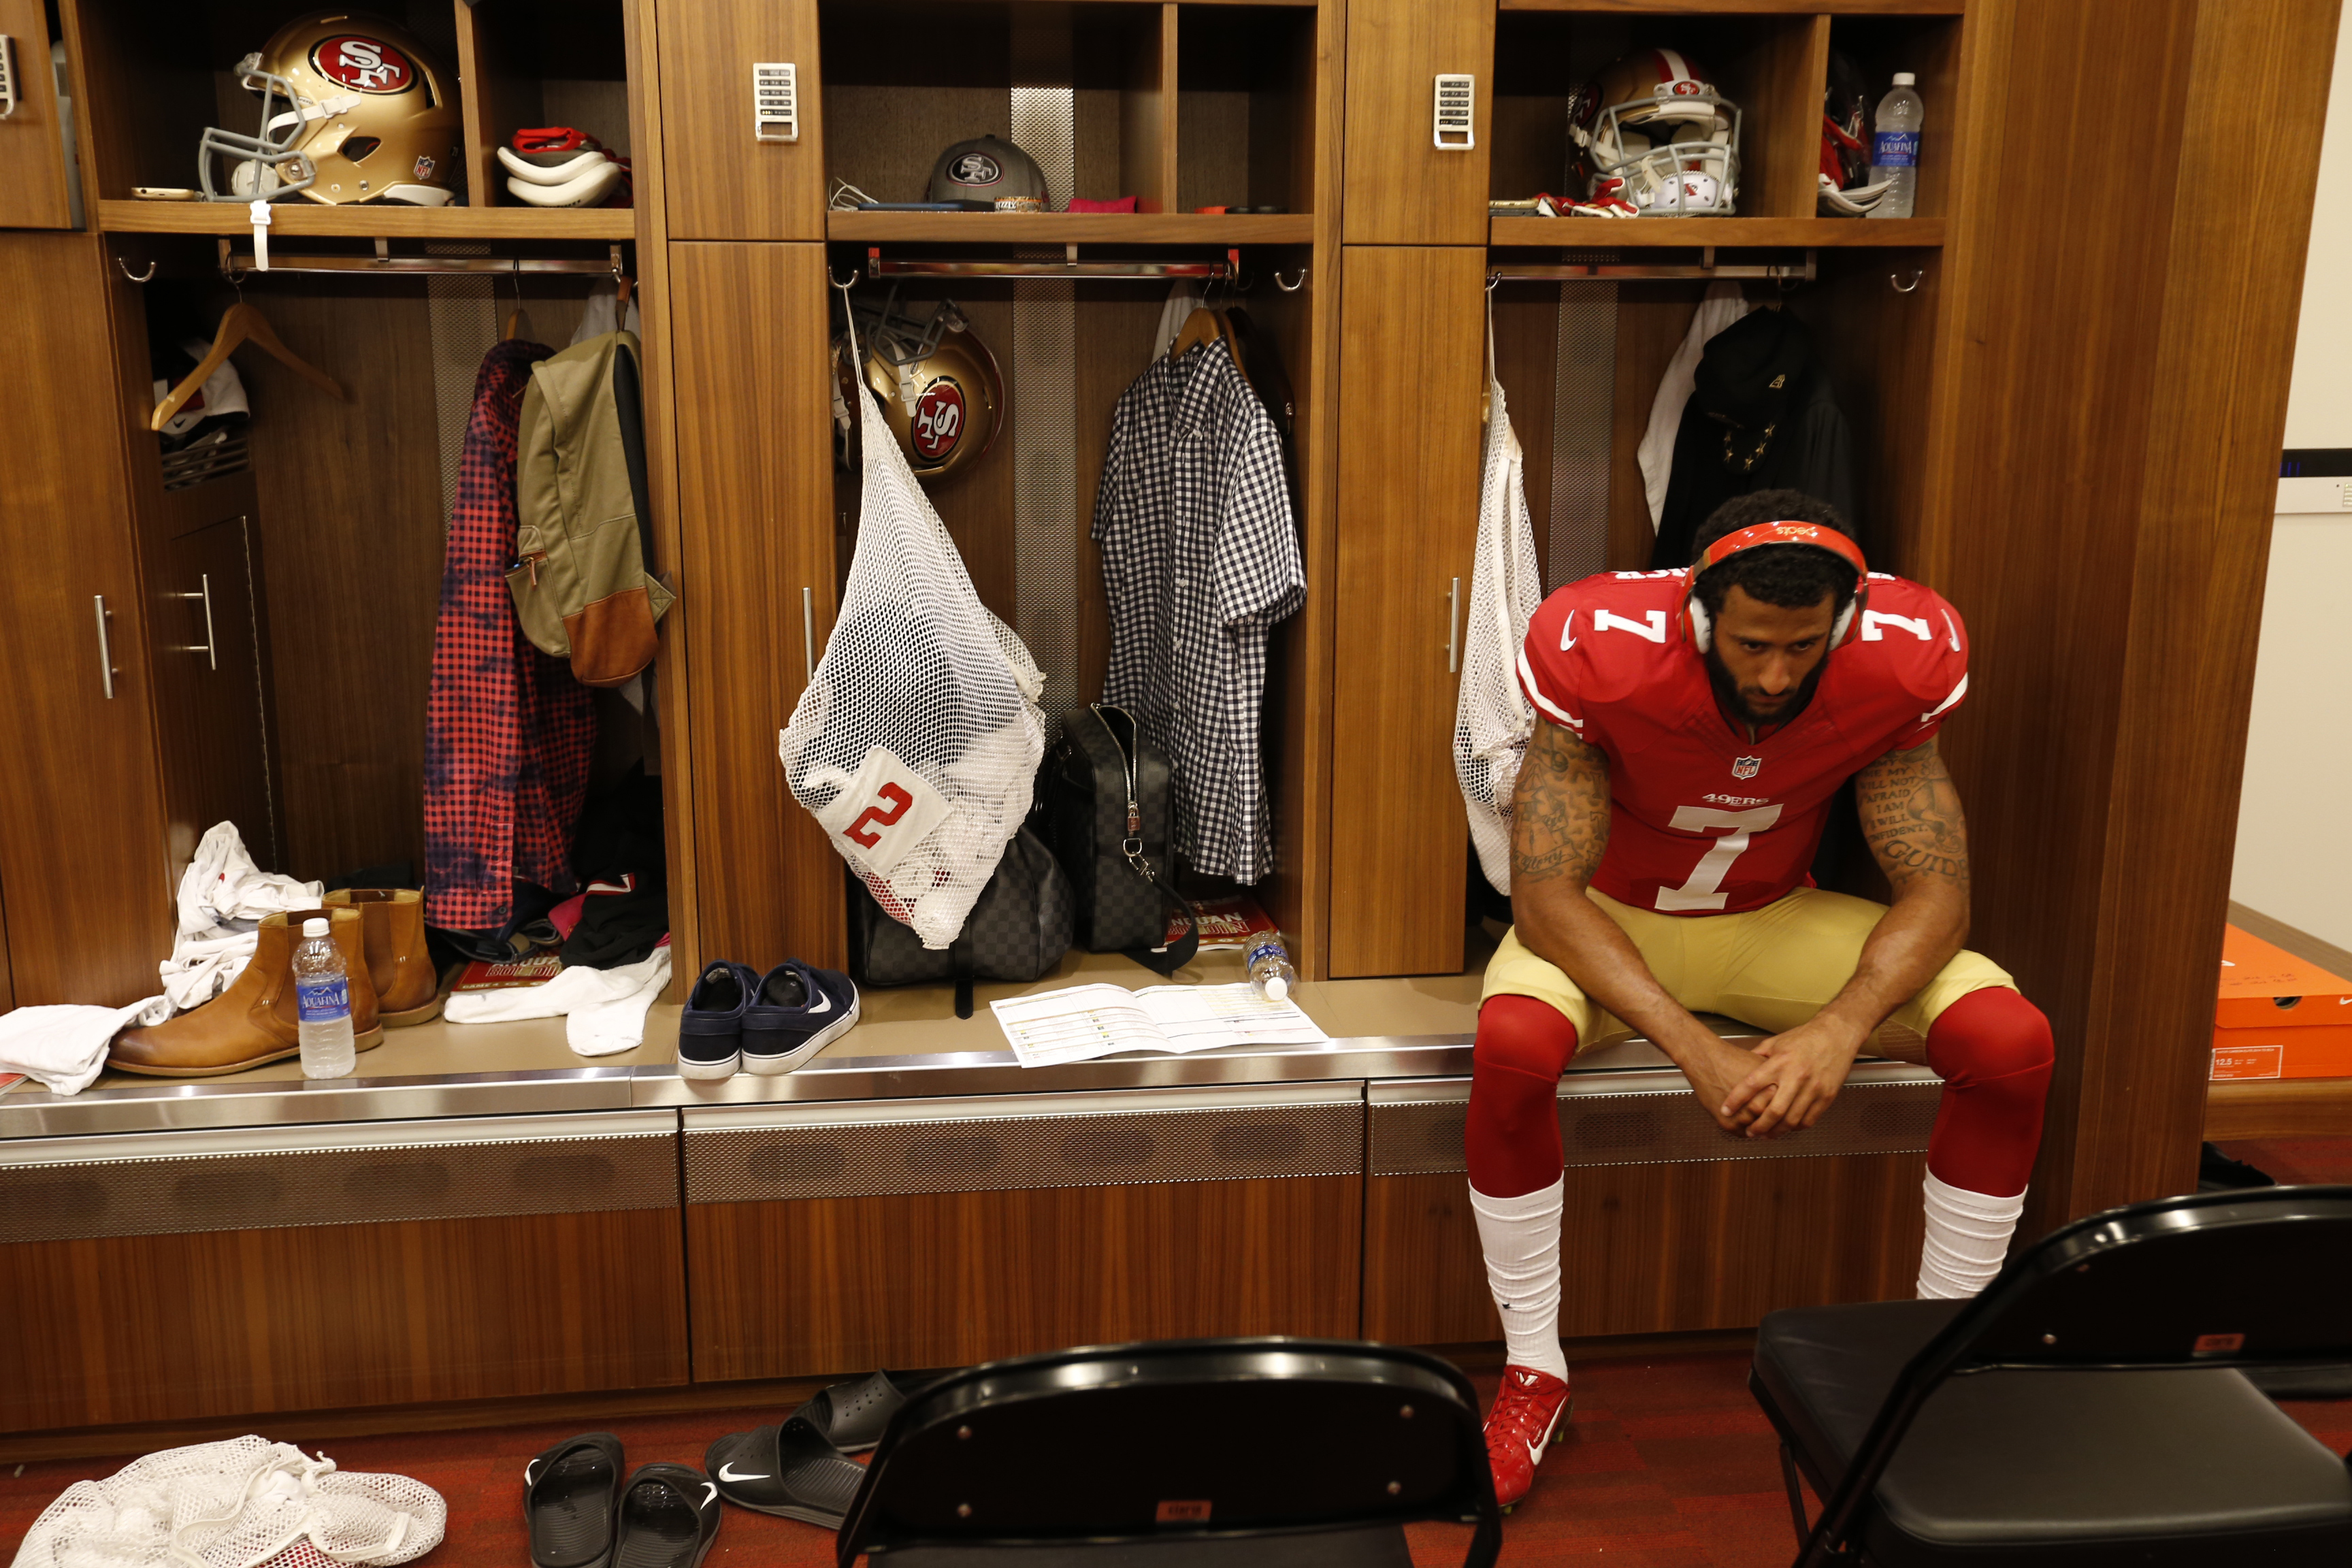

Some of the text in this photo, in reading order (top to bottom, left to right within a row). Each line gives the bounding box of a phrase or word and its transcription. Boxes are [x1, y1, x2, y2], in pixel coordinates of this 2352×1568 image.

[339, 41, 401, 88] SF
[960, 157, 993, 183] SF
[1594, 609, 1667, 644] 7
[1861, 609, 1931, 642] 7
[1736, 766, 1754, 775] NFL
[1890, 776, 1918, 787] NOT
[1702, 793, 1769, 806] 49ERS
[1867, 789, 1911, 804] AFRAID
[843, 781, 913, 849] 2
[1884, 801, 1905, 813] AM
[1878, 814, 1910, 826] WILL
[1654, 803, 1784, 911] 7
[302, 992, 340, 1009] AQUAFINA
